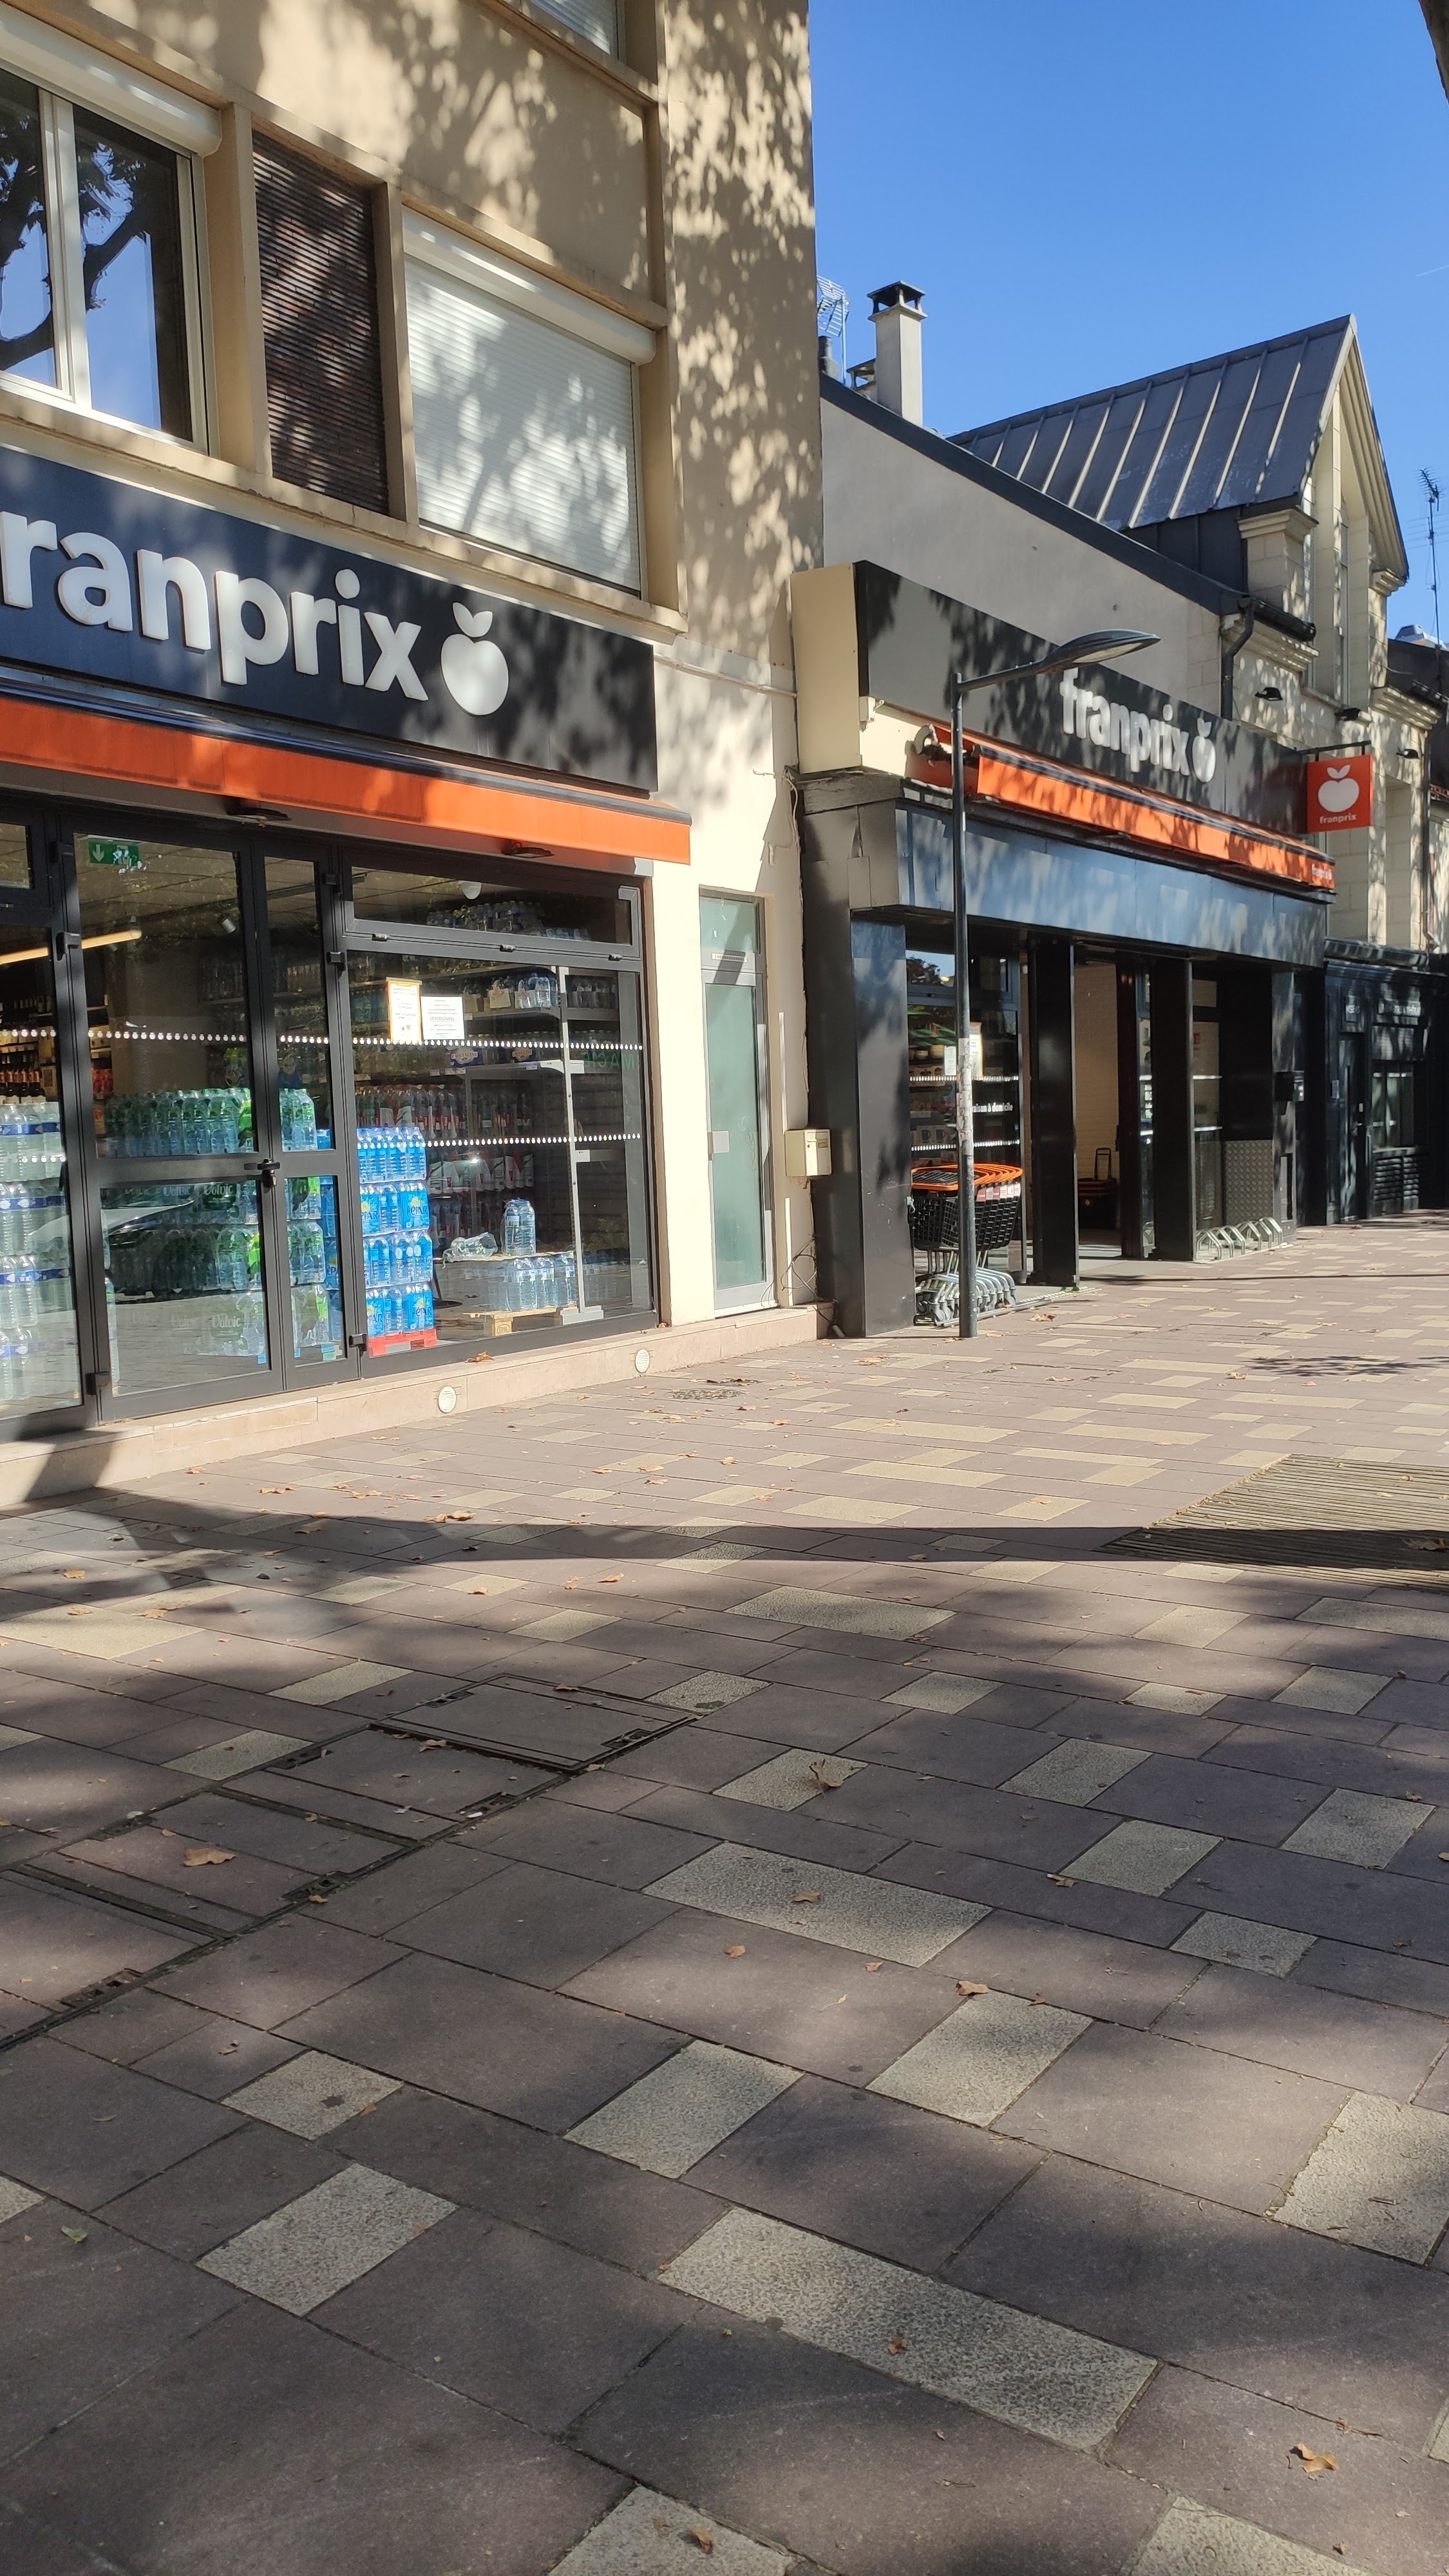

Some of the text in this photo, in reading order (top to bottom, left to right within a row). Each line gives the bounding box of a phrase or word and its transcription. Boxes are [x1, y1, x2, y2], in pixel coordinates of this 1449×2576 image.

[0, 511, 429, 701] ranprix
[1059, 667, 1190, 776] franprix
[1320, 812, 1357, 824] franprix
[203, 1184, 234, 1196] Volvic
[211, 1314, 241, 1329] Volvic
